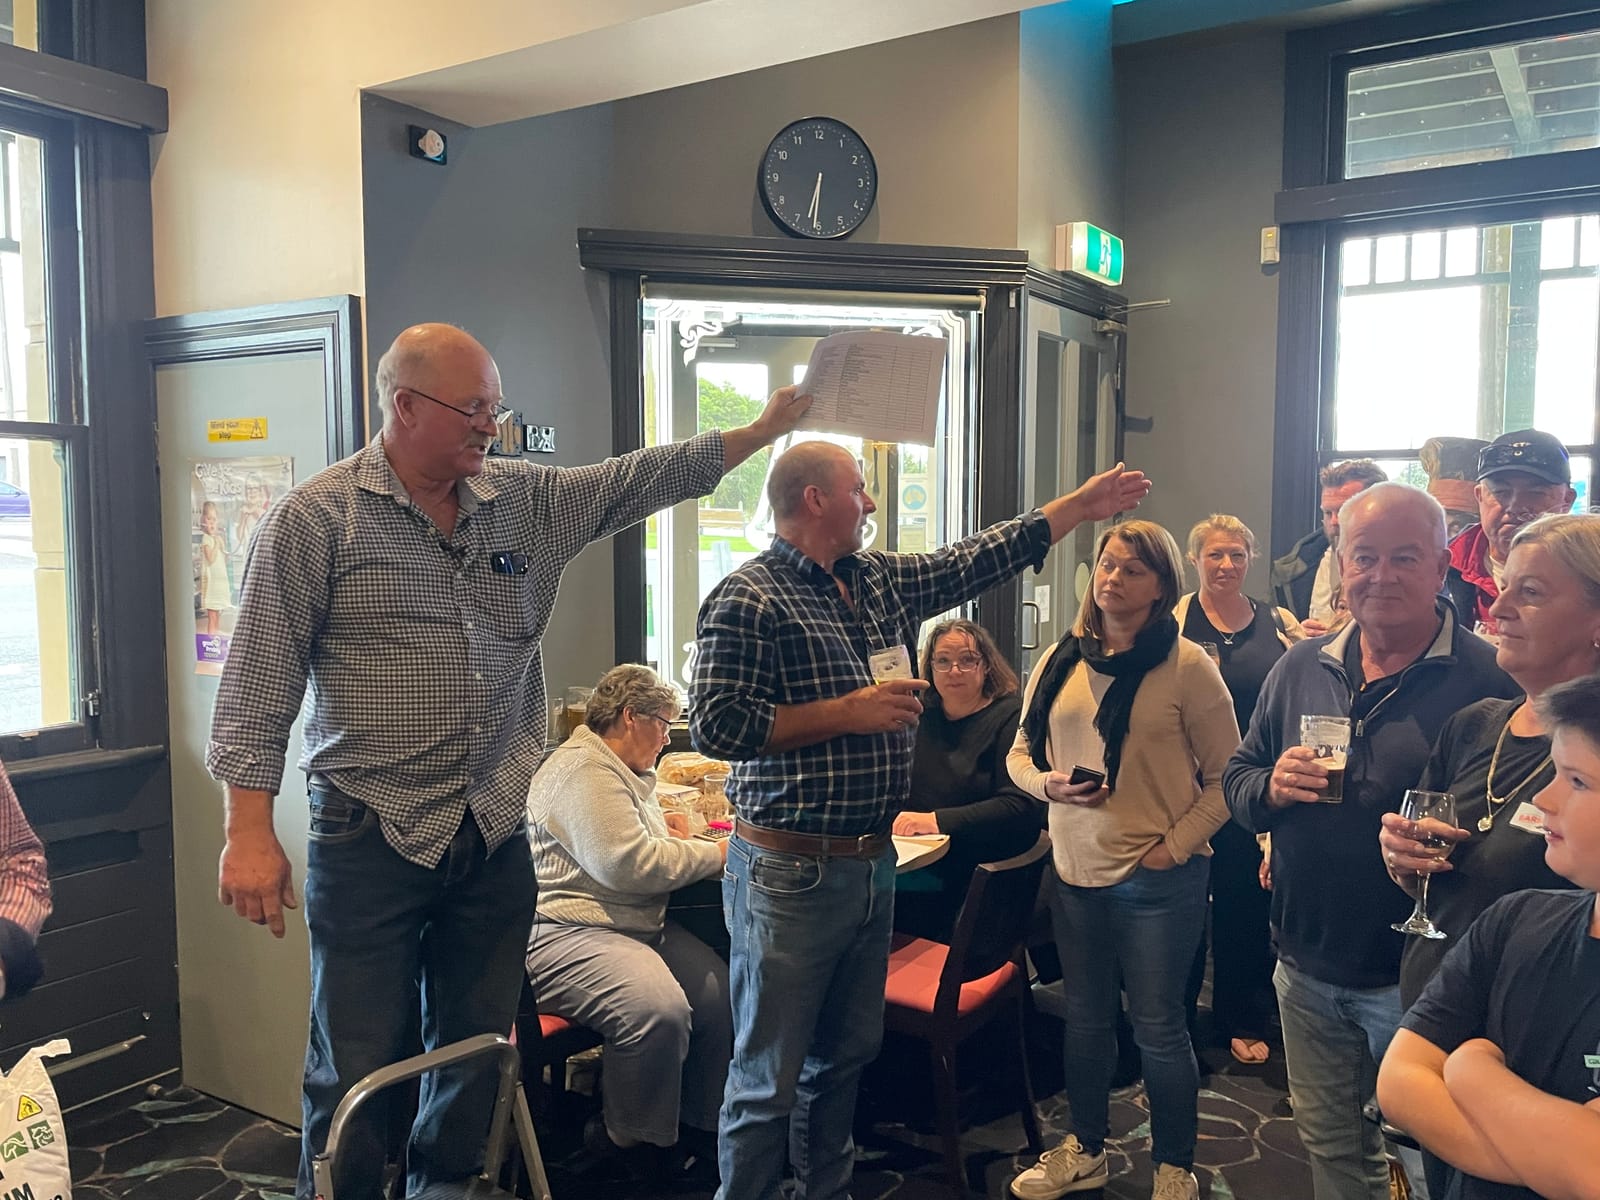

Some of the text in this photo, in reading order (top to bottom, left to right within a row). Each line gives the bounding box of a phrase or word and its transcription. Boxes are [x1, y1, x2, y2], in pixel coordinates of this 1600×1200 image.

[815, 130, 824, 140] 12
[793, 136, 802, 144] 11
[778, 151, 788, 160] 10
